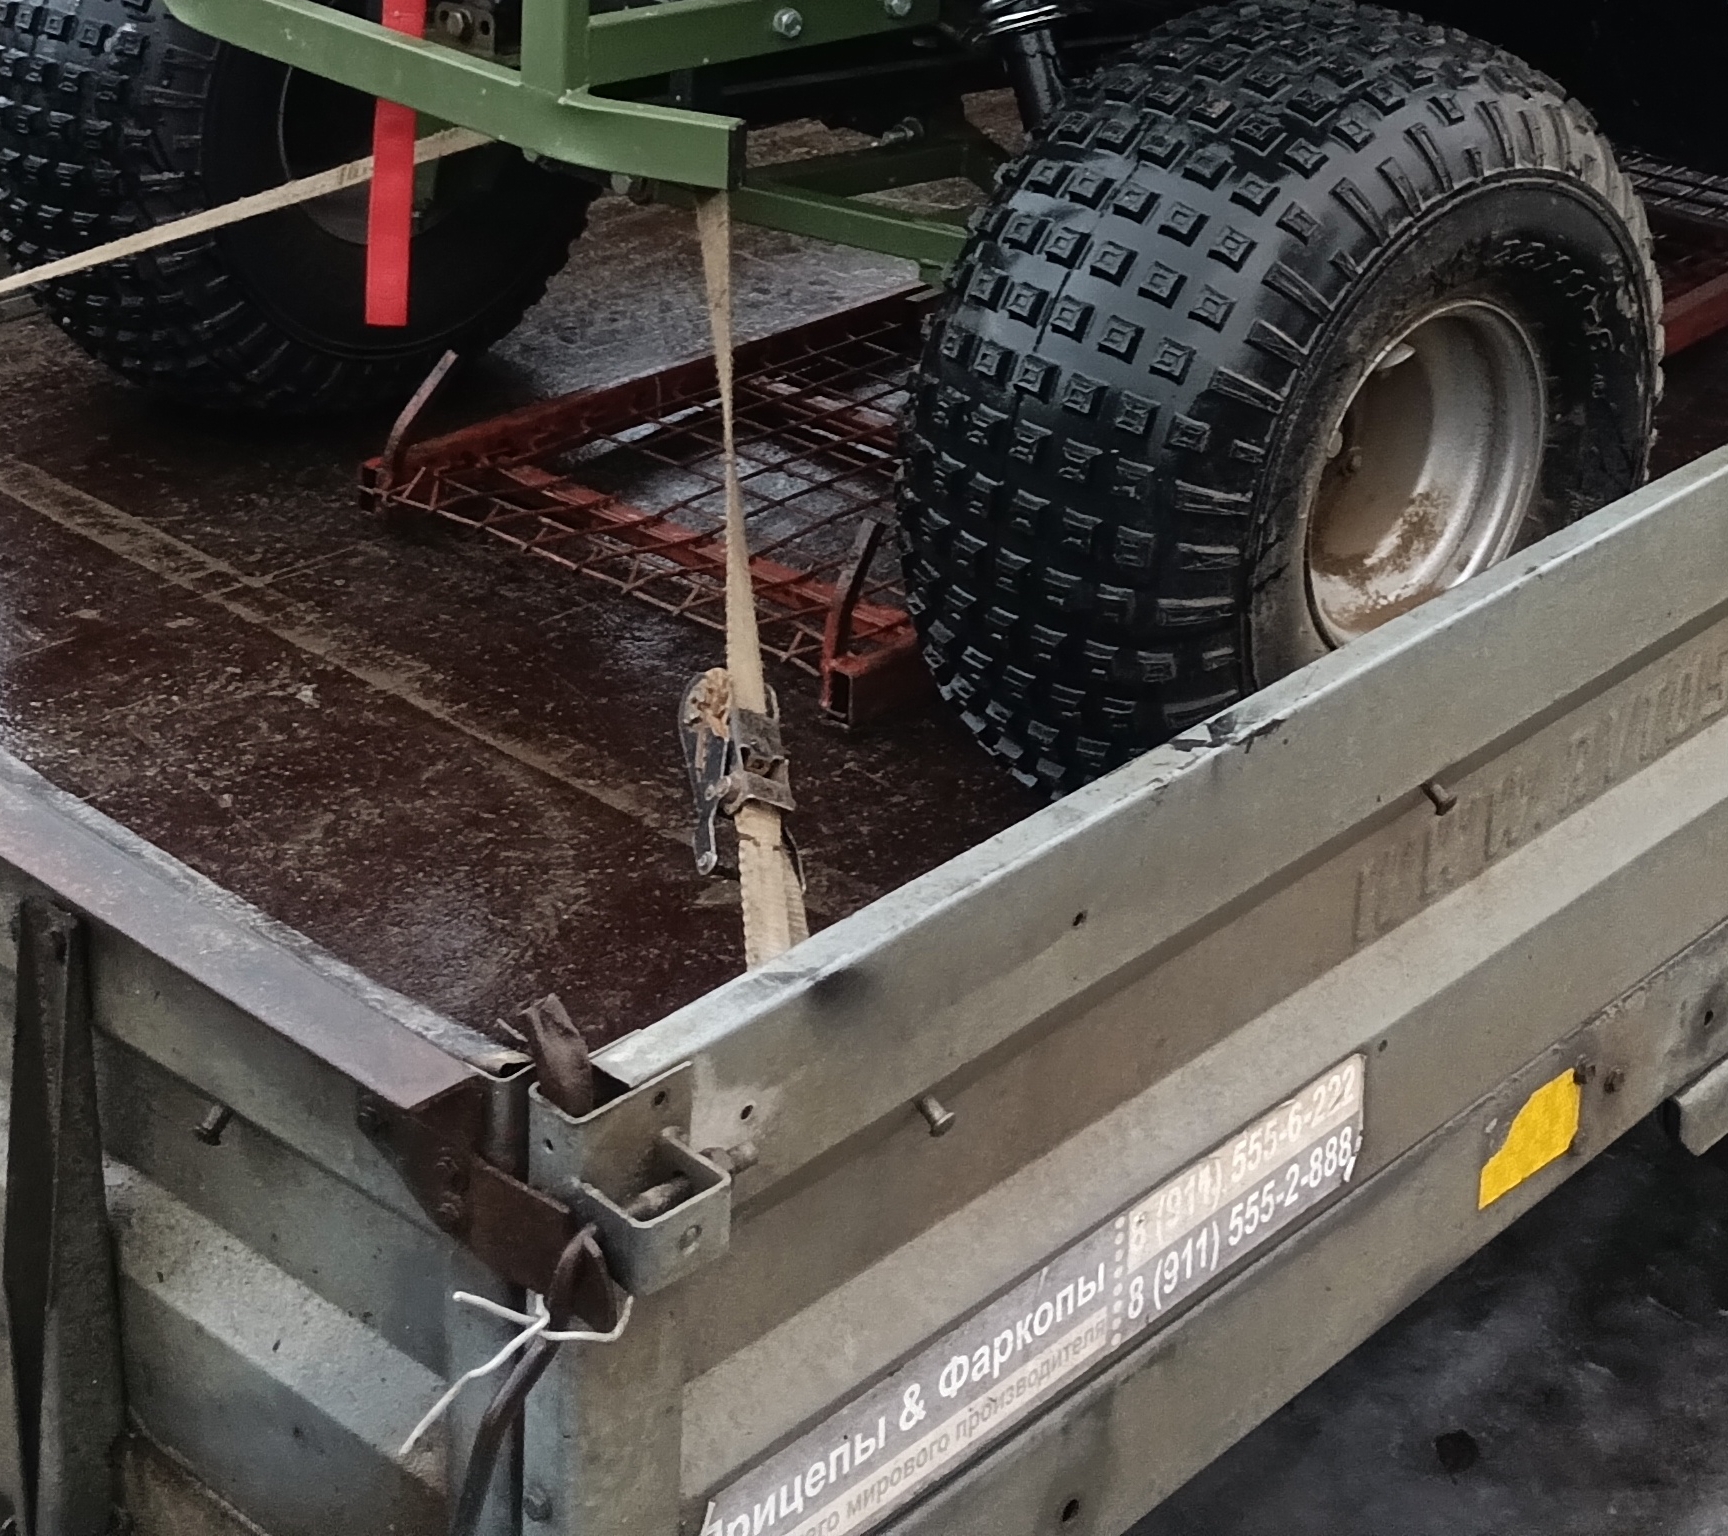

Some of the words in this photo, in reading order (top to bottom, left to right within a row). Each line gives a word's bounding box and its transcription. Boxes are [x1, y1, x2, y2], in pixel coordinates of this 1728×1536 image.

[1128, 1275, 1144, 1319] 8
[1153, 1221, 1220, 1310] (911)
[1228, 1126, 1353, 1247] 555-2-888
[1129, 1213, 1147, 1252] 8
[1230, 1064, 1357, 1184] 555-6-222
[899, 1382, 927, 1432] &
[938, 1262, 1105, 1398] Фаркопы
[846, 1432, 950, 1518] мирового
